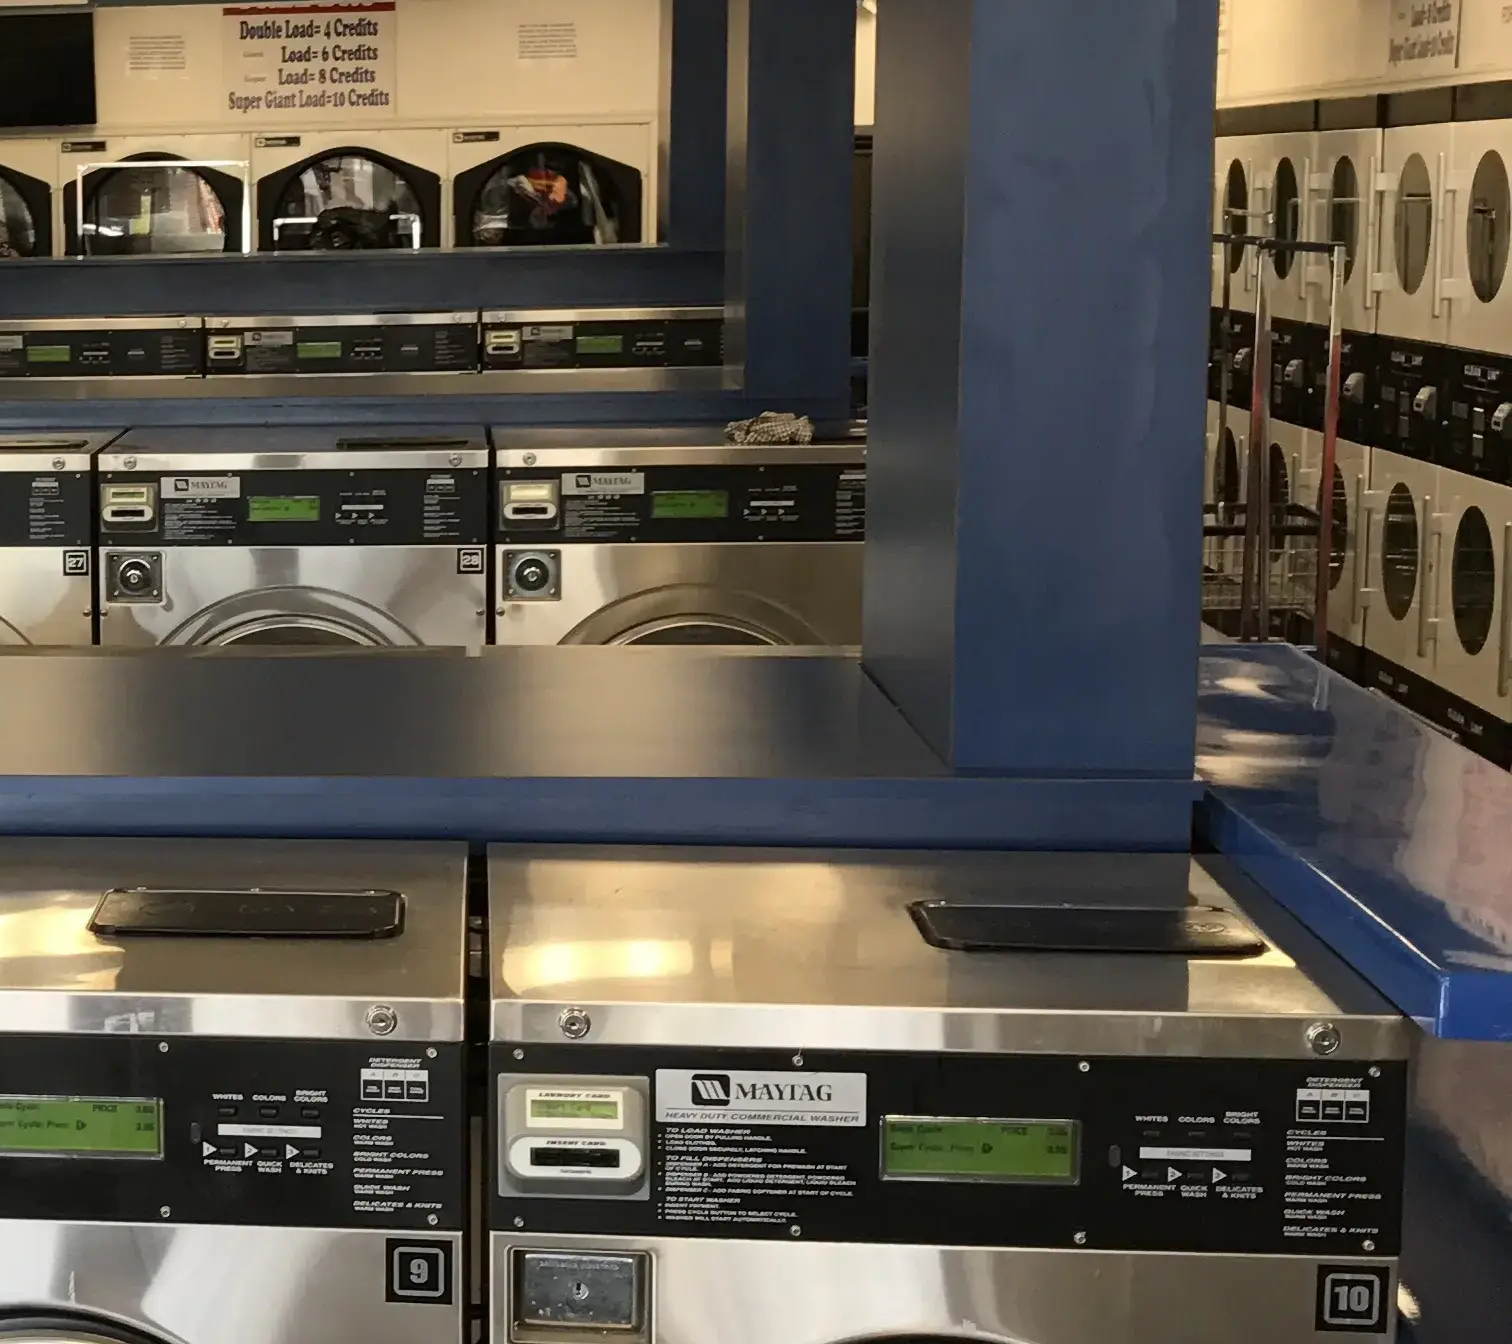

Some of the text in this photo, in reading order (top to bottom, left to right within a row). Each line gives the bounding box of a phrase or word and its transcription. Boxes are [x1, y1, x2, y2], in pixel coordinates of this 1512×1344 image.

[240, 18, 378, 40] Double Load= 4 Credits
[281, 44, 378, 63] Load= 6 Credits
[278, 67, 376, 85] Load= 8 Credits
[228, 91, 262, 113] Super
[265, 90, 296, 108] Giant
[348, 88, 390, 106] Credits
[190, 480, 228, 489] MAYTAG
[68, 557, 84, 567] 27
[462, 555, 478, 565] 28
[735, 1083, 832, 1101] MAYTAG
[731, 1113, 807, 1121] COMMERCIAL
[409, 1258, 429, 1284] 9
[1334, 1285, 1370, 1312] 10
